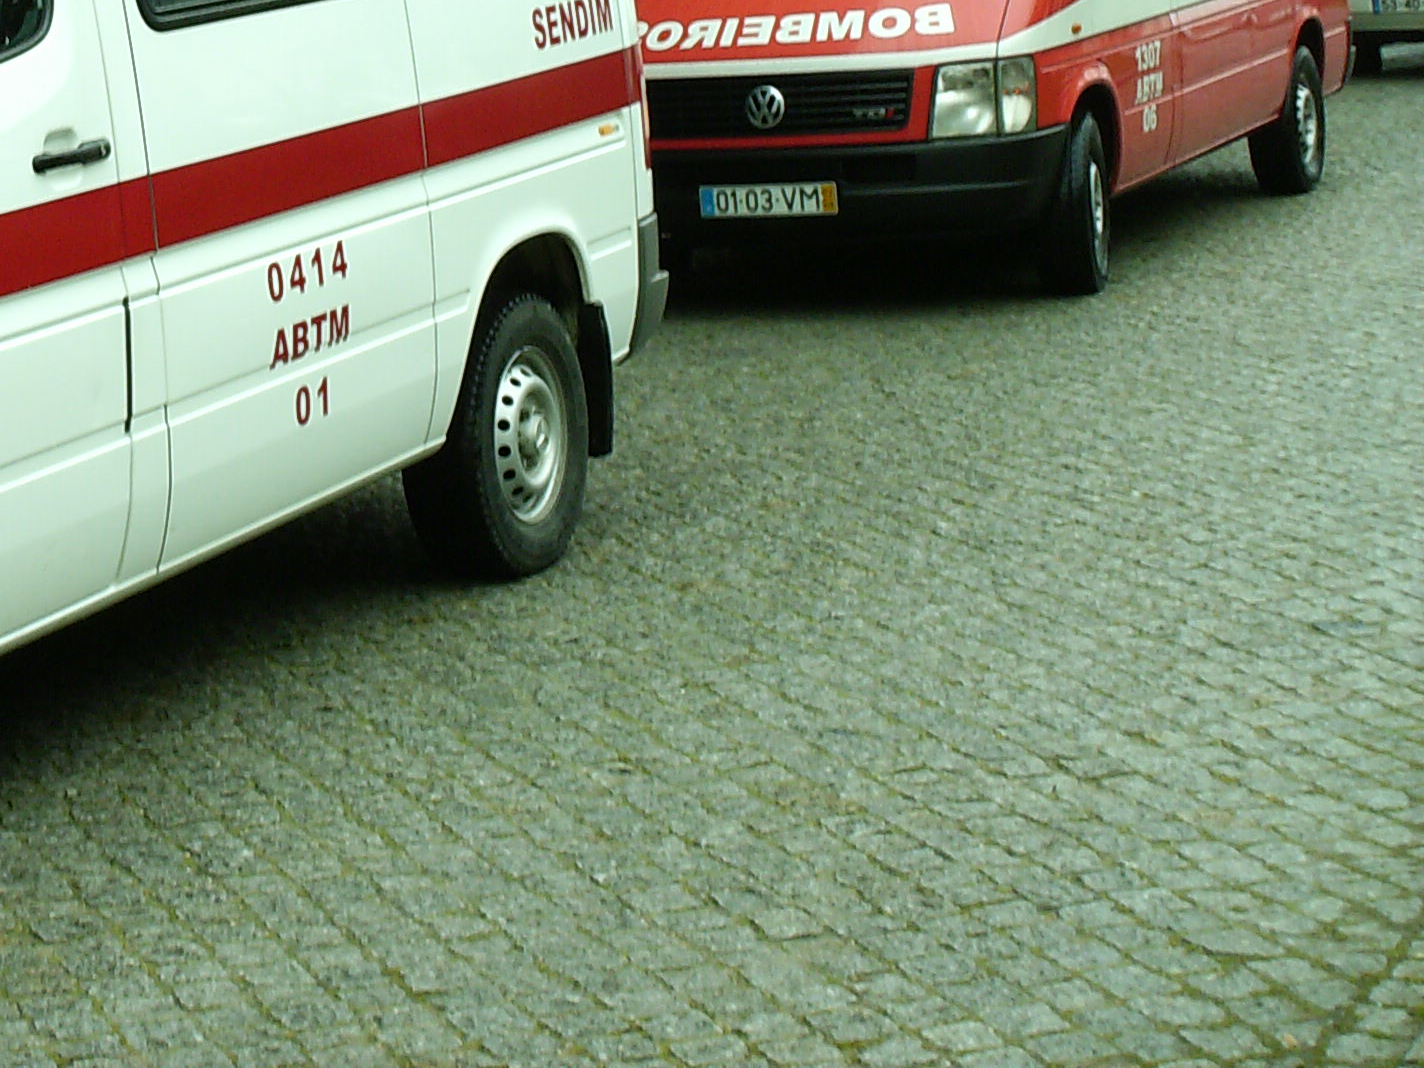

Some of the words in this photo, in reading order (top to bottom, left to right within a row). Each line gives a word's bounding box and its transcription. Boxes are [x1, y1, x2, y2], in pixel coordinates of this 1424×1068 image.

[267, 240, 347, 303] 0414
[269, 304, 349, 371] ABTM
[296, 377, 328, 426] 01
